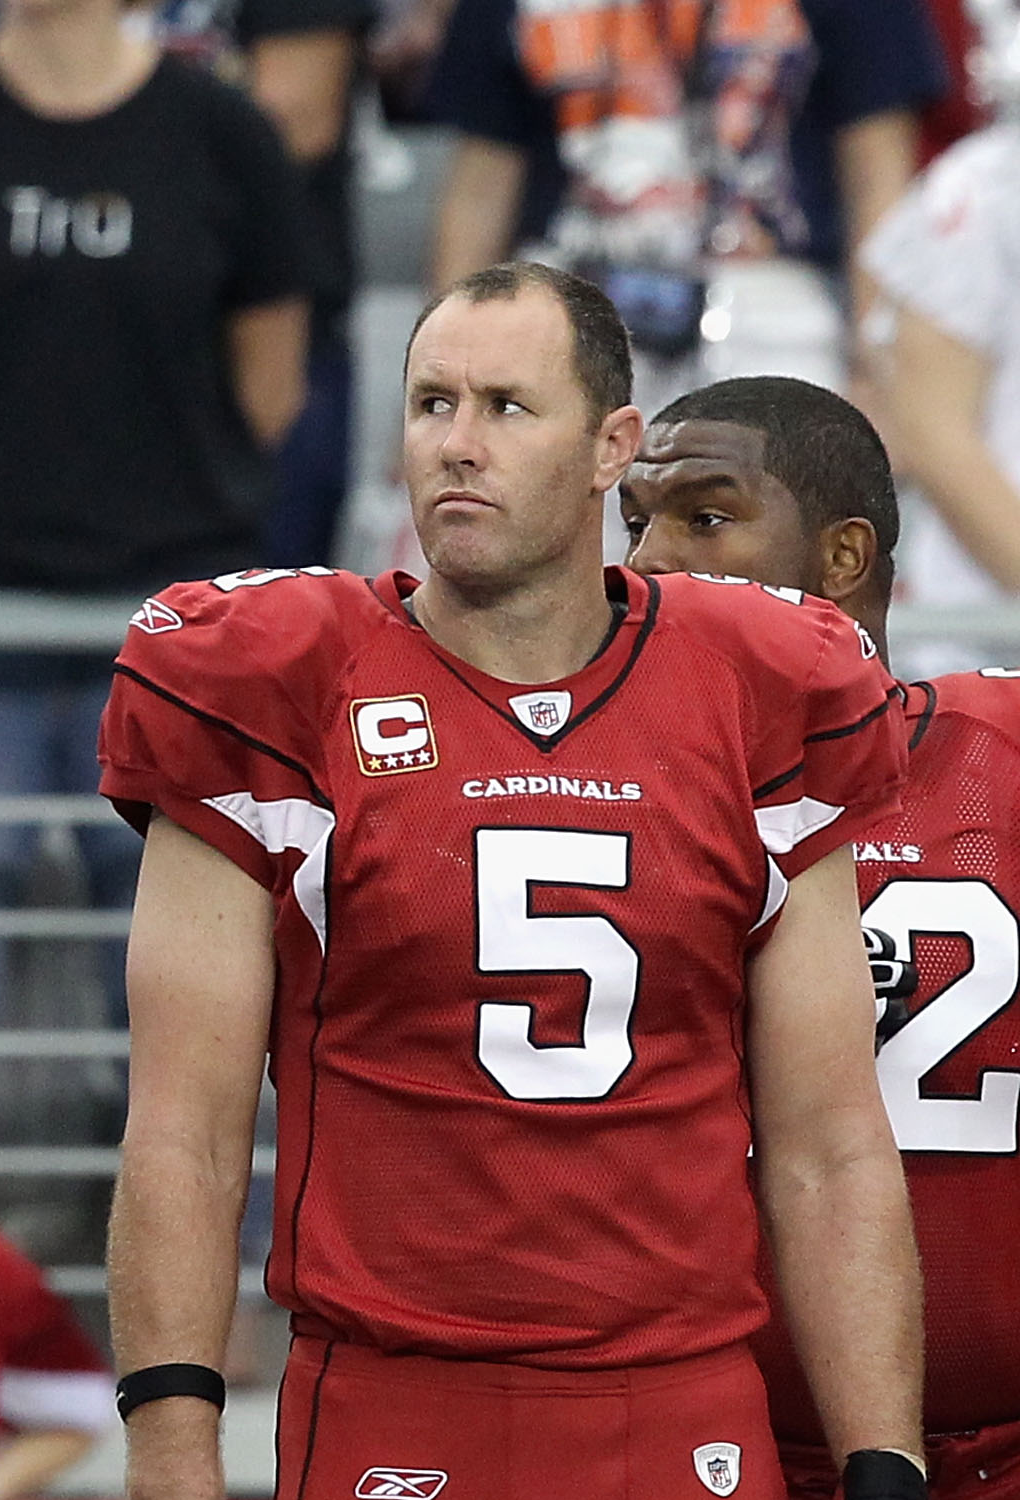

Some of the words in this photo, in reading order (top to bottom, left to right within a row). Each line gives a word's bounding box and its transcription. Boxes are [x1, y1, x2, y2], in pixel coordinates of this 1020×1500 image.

[356, 700, 430, 756] C
[462, 775, 642, 800] CARDINALS
[476, 828, 640, 1100] 5
